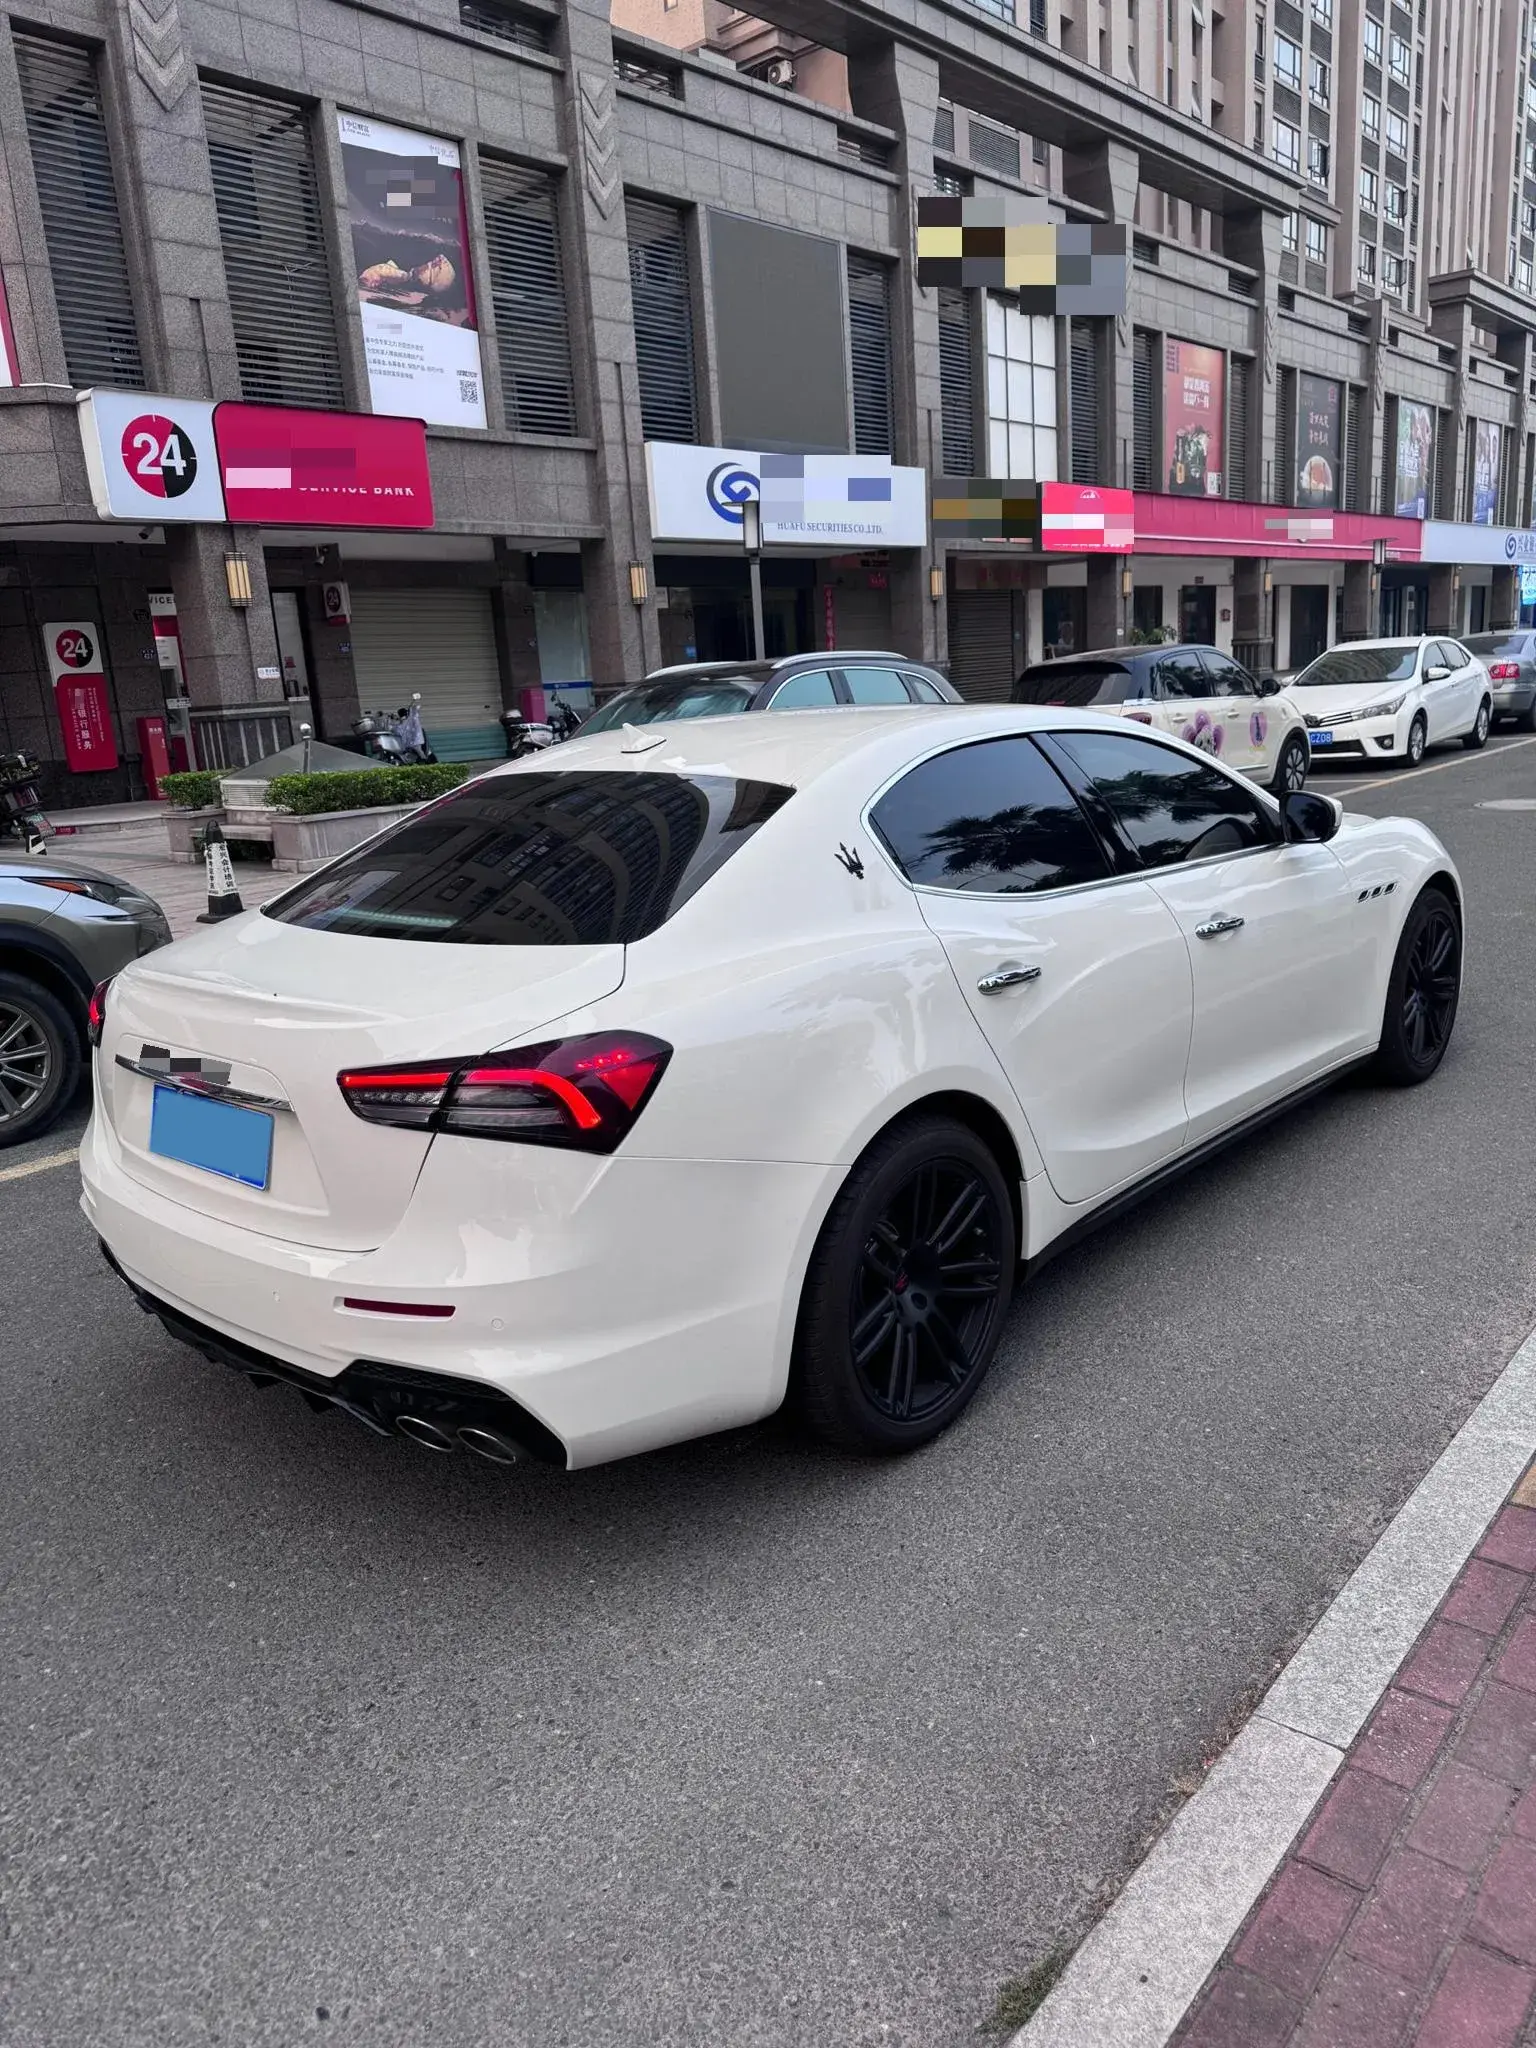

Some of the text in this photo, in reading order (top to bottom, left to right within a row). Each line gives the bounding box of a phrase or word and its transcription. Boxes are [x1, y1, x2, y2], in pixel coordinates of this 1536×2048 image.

[133, 432, 186, 476] 24
[807, 522, 853, 533] SECURITIES
[61, 637, 88, 658] 24
